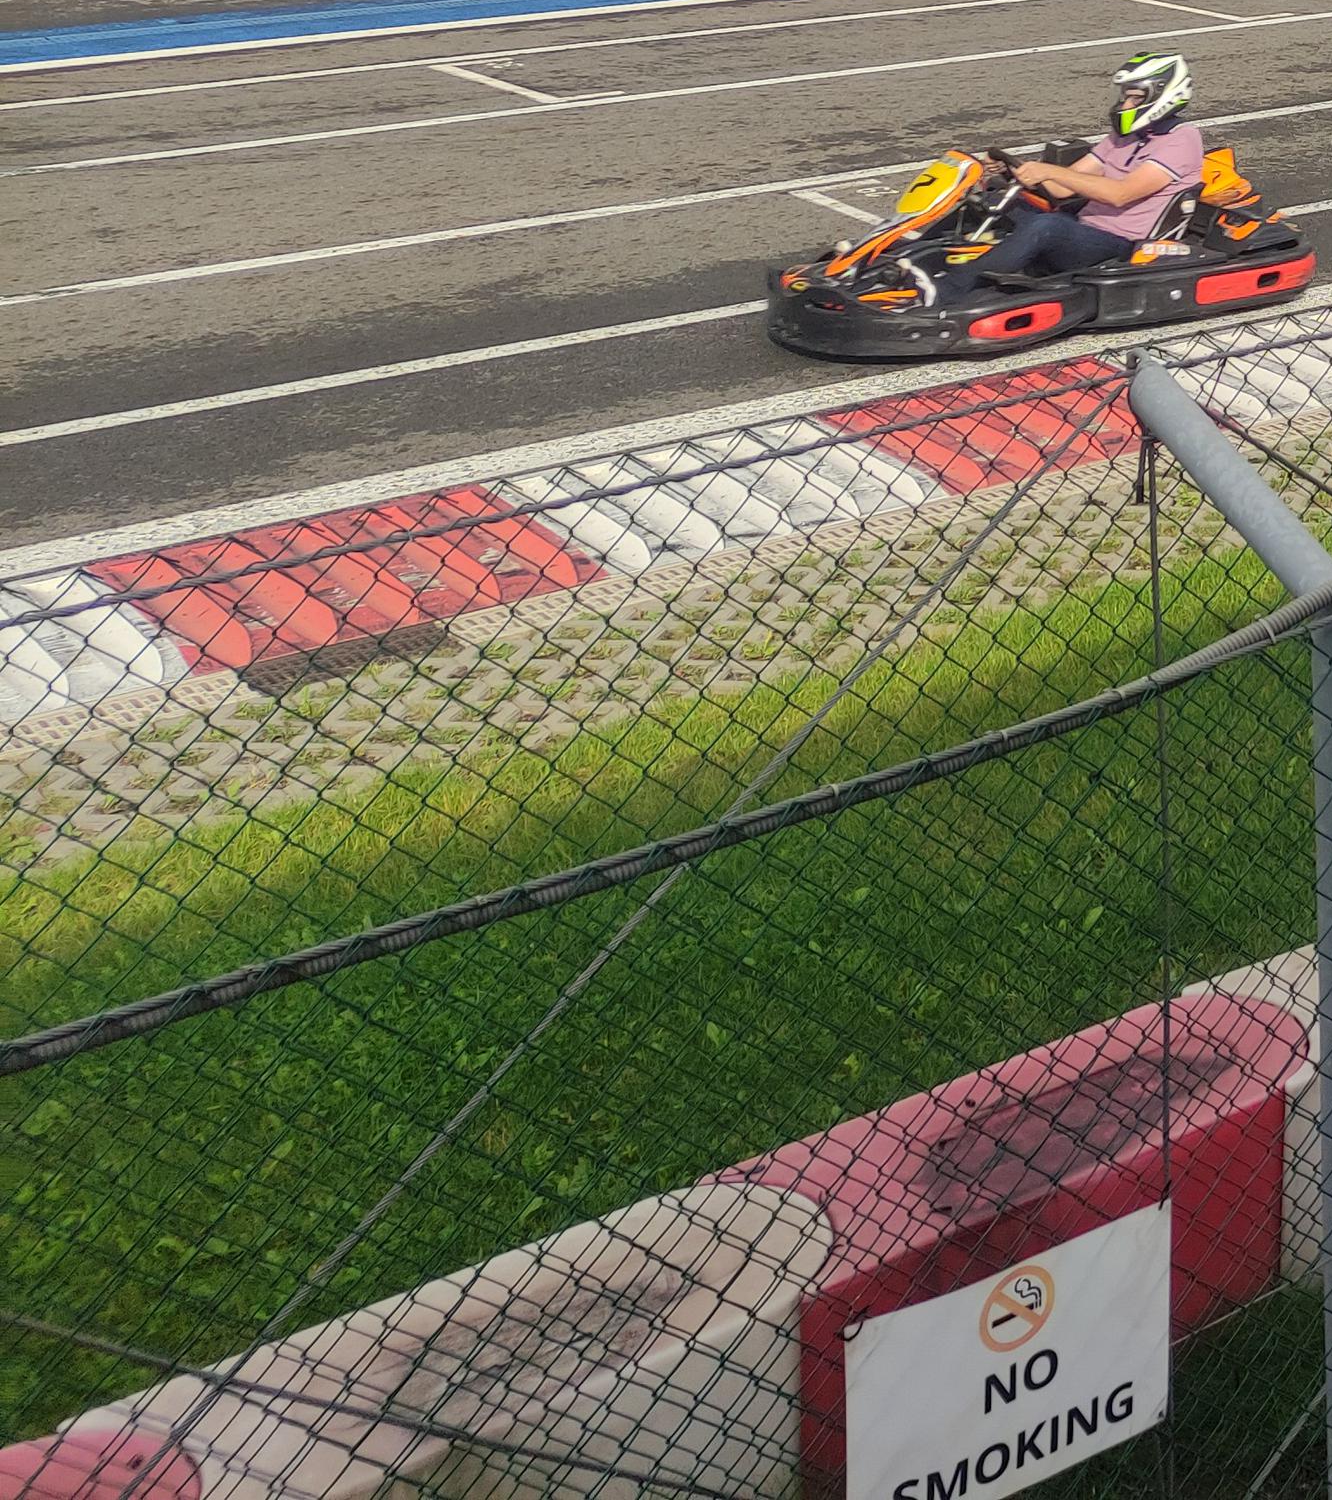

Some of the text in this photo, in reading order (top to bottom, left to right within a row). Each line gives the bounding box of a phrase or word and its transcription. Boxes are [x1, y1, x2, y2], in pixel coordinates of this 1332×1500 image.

[908, 173, 938, 193] 7
[983, 1348, 1059, 1414] NO
[892, 1381, 1134, 1500] SMOKING
